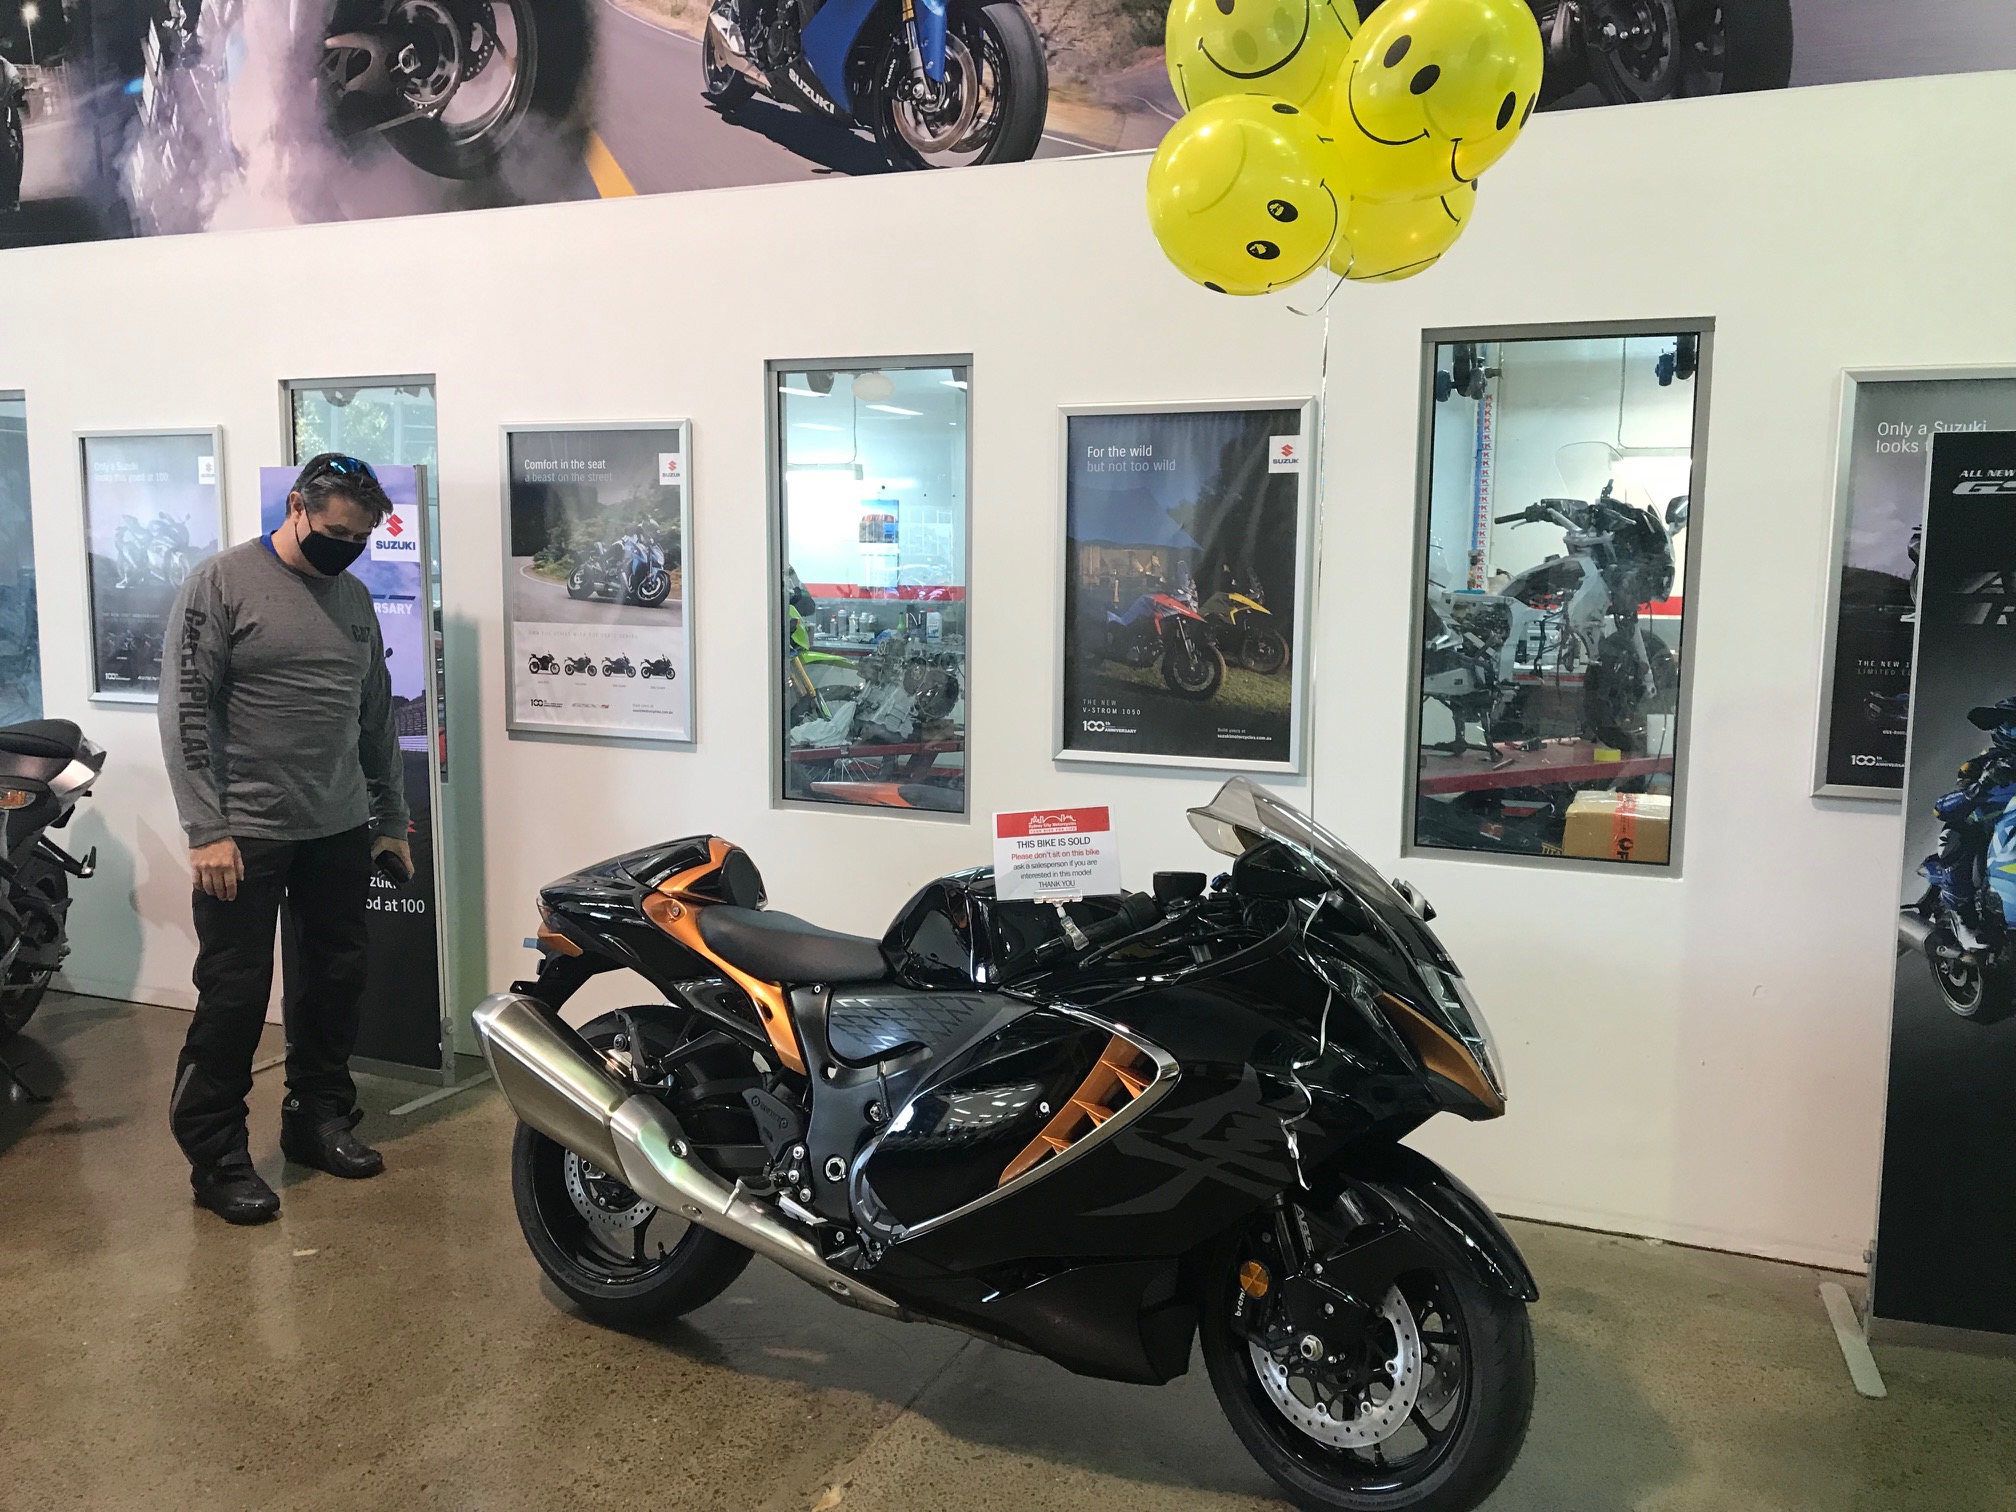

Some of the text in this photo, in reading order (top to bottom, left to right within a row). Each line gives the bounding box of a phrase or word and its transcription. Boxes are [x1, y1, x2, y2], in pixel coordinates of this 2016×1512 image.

[788, 68, 835, 115] SUZUKI
[1877, 421, 1913, 438] Only
[1918, 424, 1927, 435] a
[1087, 445, 1152, 458] For the wild
[1876, 439, 1919, 453] looks
[525, 459, 606, 470] Comfort in the seat
[1087, 459, 1176, 472] but not too wild
[525, 472, 612, 482] a beast on the street
[1959, 469, 2016, 478] ALL NEW
[376, 540, 416, 550] SUZUKI
[351, 624, 370, 642] CAT
[178, 608, 210, 771] CATERPILLAR
[1017, 836, 1091, 849] THIS BIKE IS SOLD
[1034, 851, 1051, 859] don't
[1031, 861, 1068, 870] salesperson
[1021, 871, 1051, 879] interested
[384, 899, 398, 912] at
[400, 898, 425, 913] 100
[1234, 1287, 1246, 1317] brem
